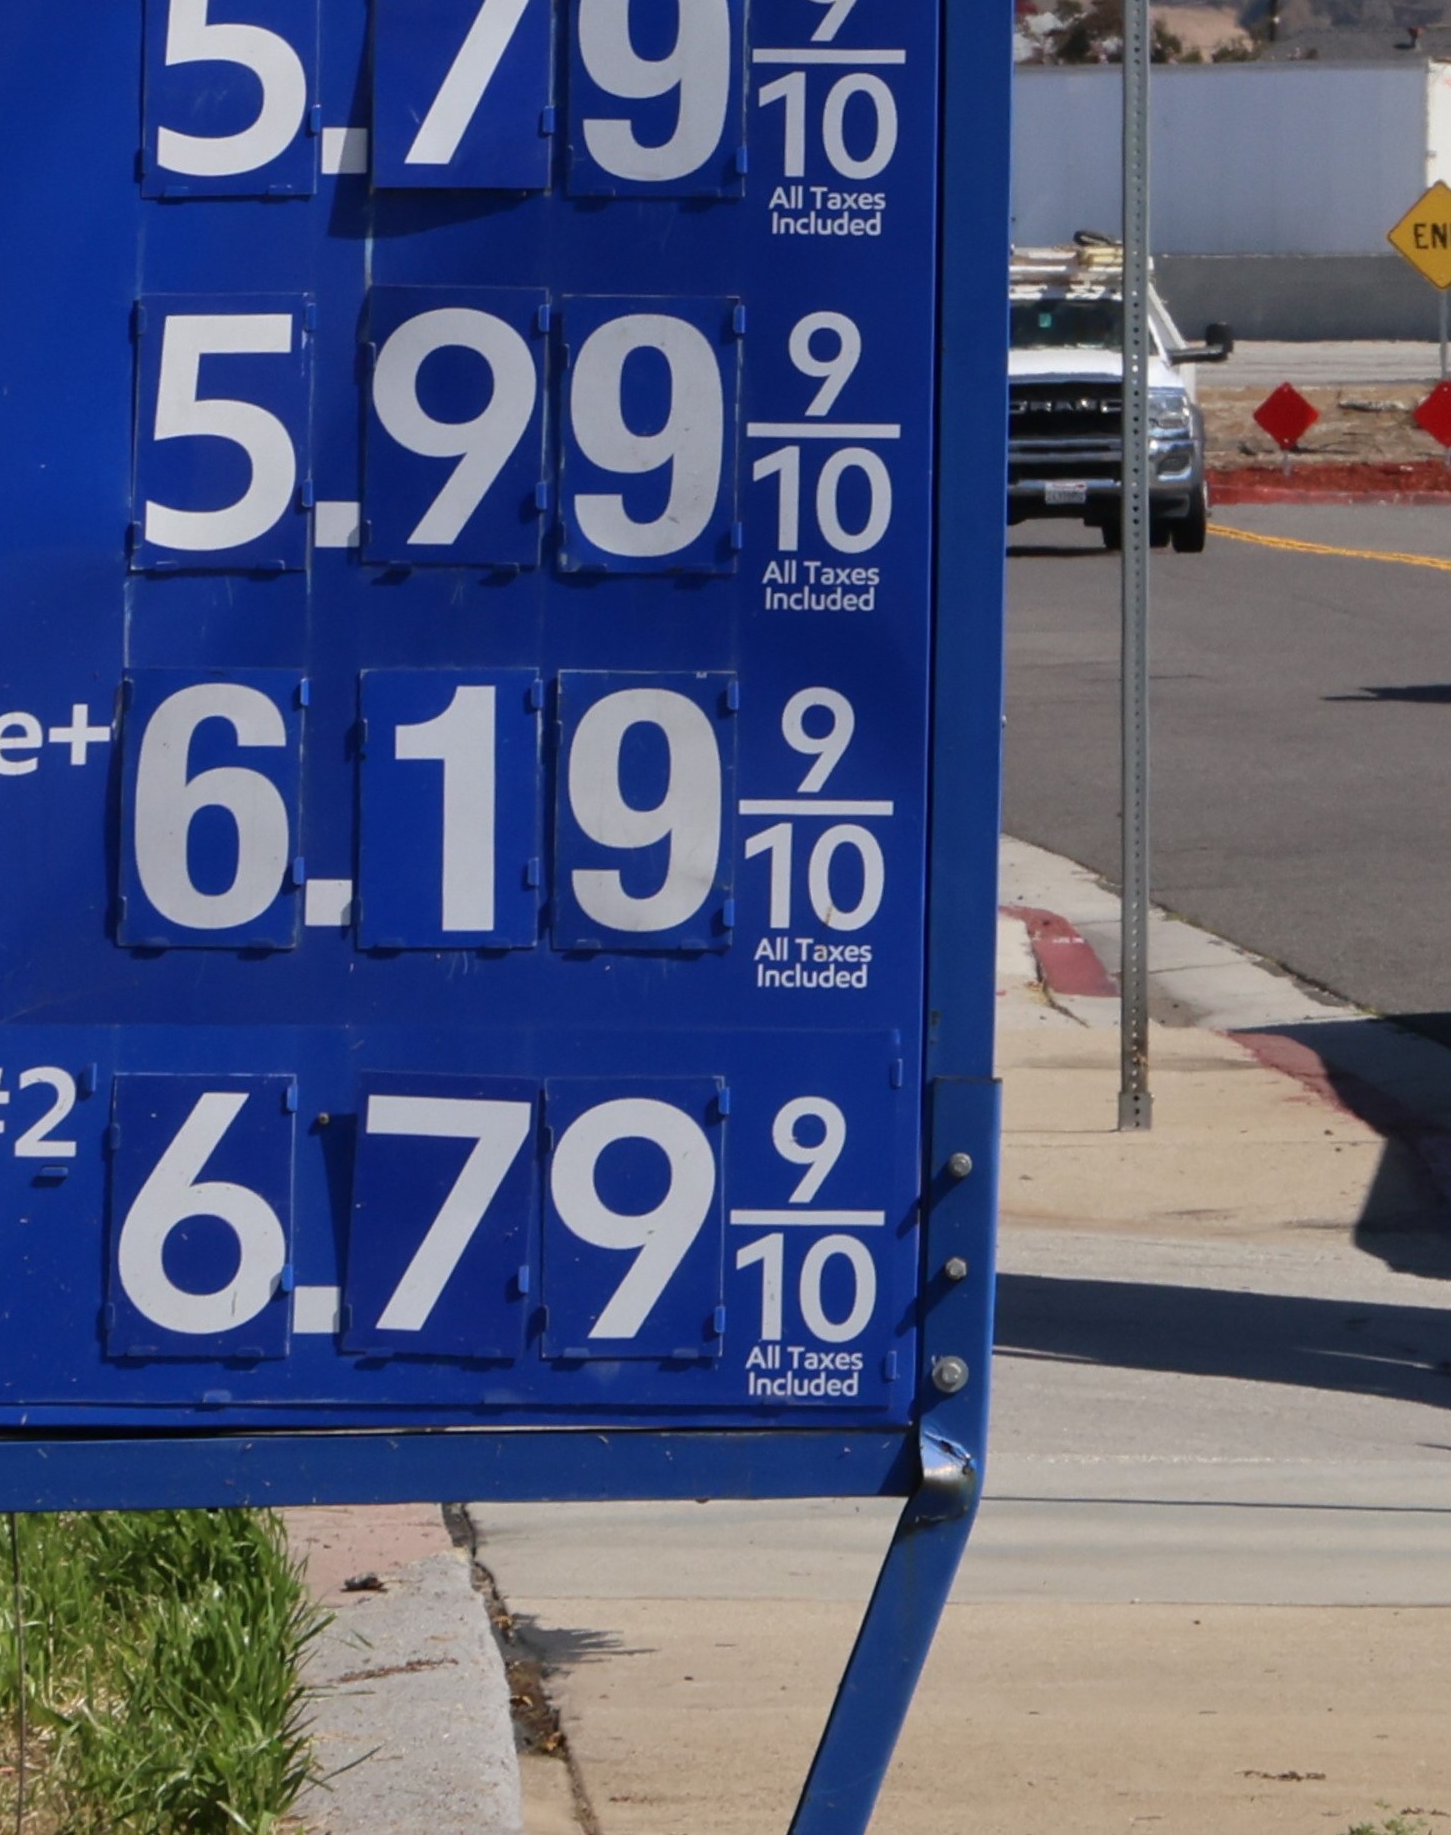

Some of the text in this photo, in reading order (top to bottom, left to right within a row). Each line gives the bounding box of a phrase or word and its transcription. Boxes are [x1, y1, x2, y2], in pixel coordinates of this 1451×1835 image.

[769, 186, 886, 210] All Taxes
[772, 211, 881, 235] Included
[145, 308, 723, 557] 5.99
[763, 560, 880, 585] All Taxes
[766, 586, 874, 611] Included
[135, 683, 722, 932] 6.19
[754, 937, 872, 963] All Taxes
[757, 963, 867, 988] Included
[118, 1092, 716, 1339] 6.79
[746, 1345, 863, 1370] All Taxes
[749, 1371, 858, 1396] Included
